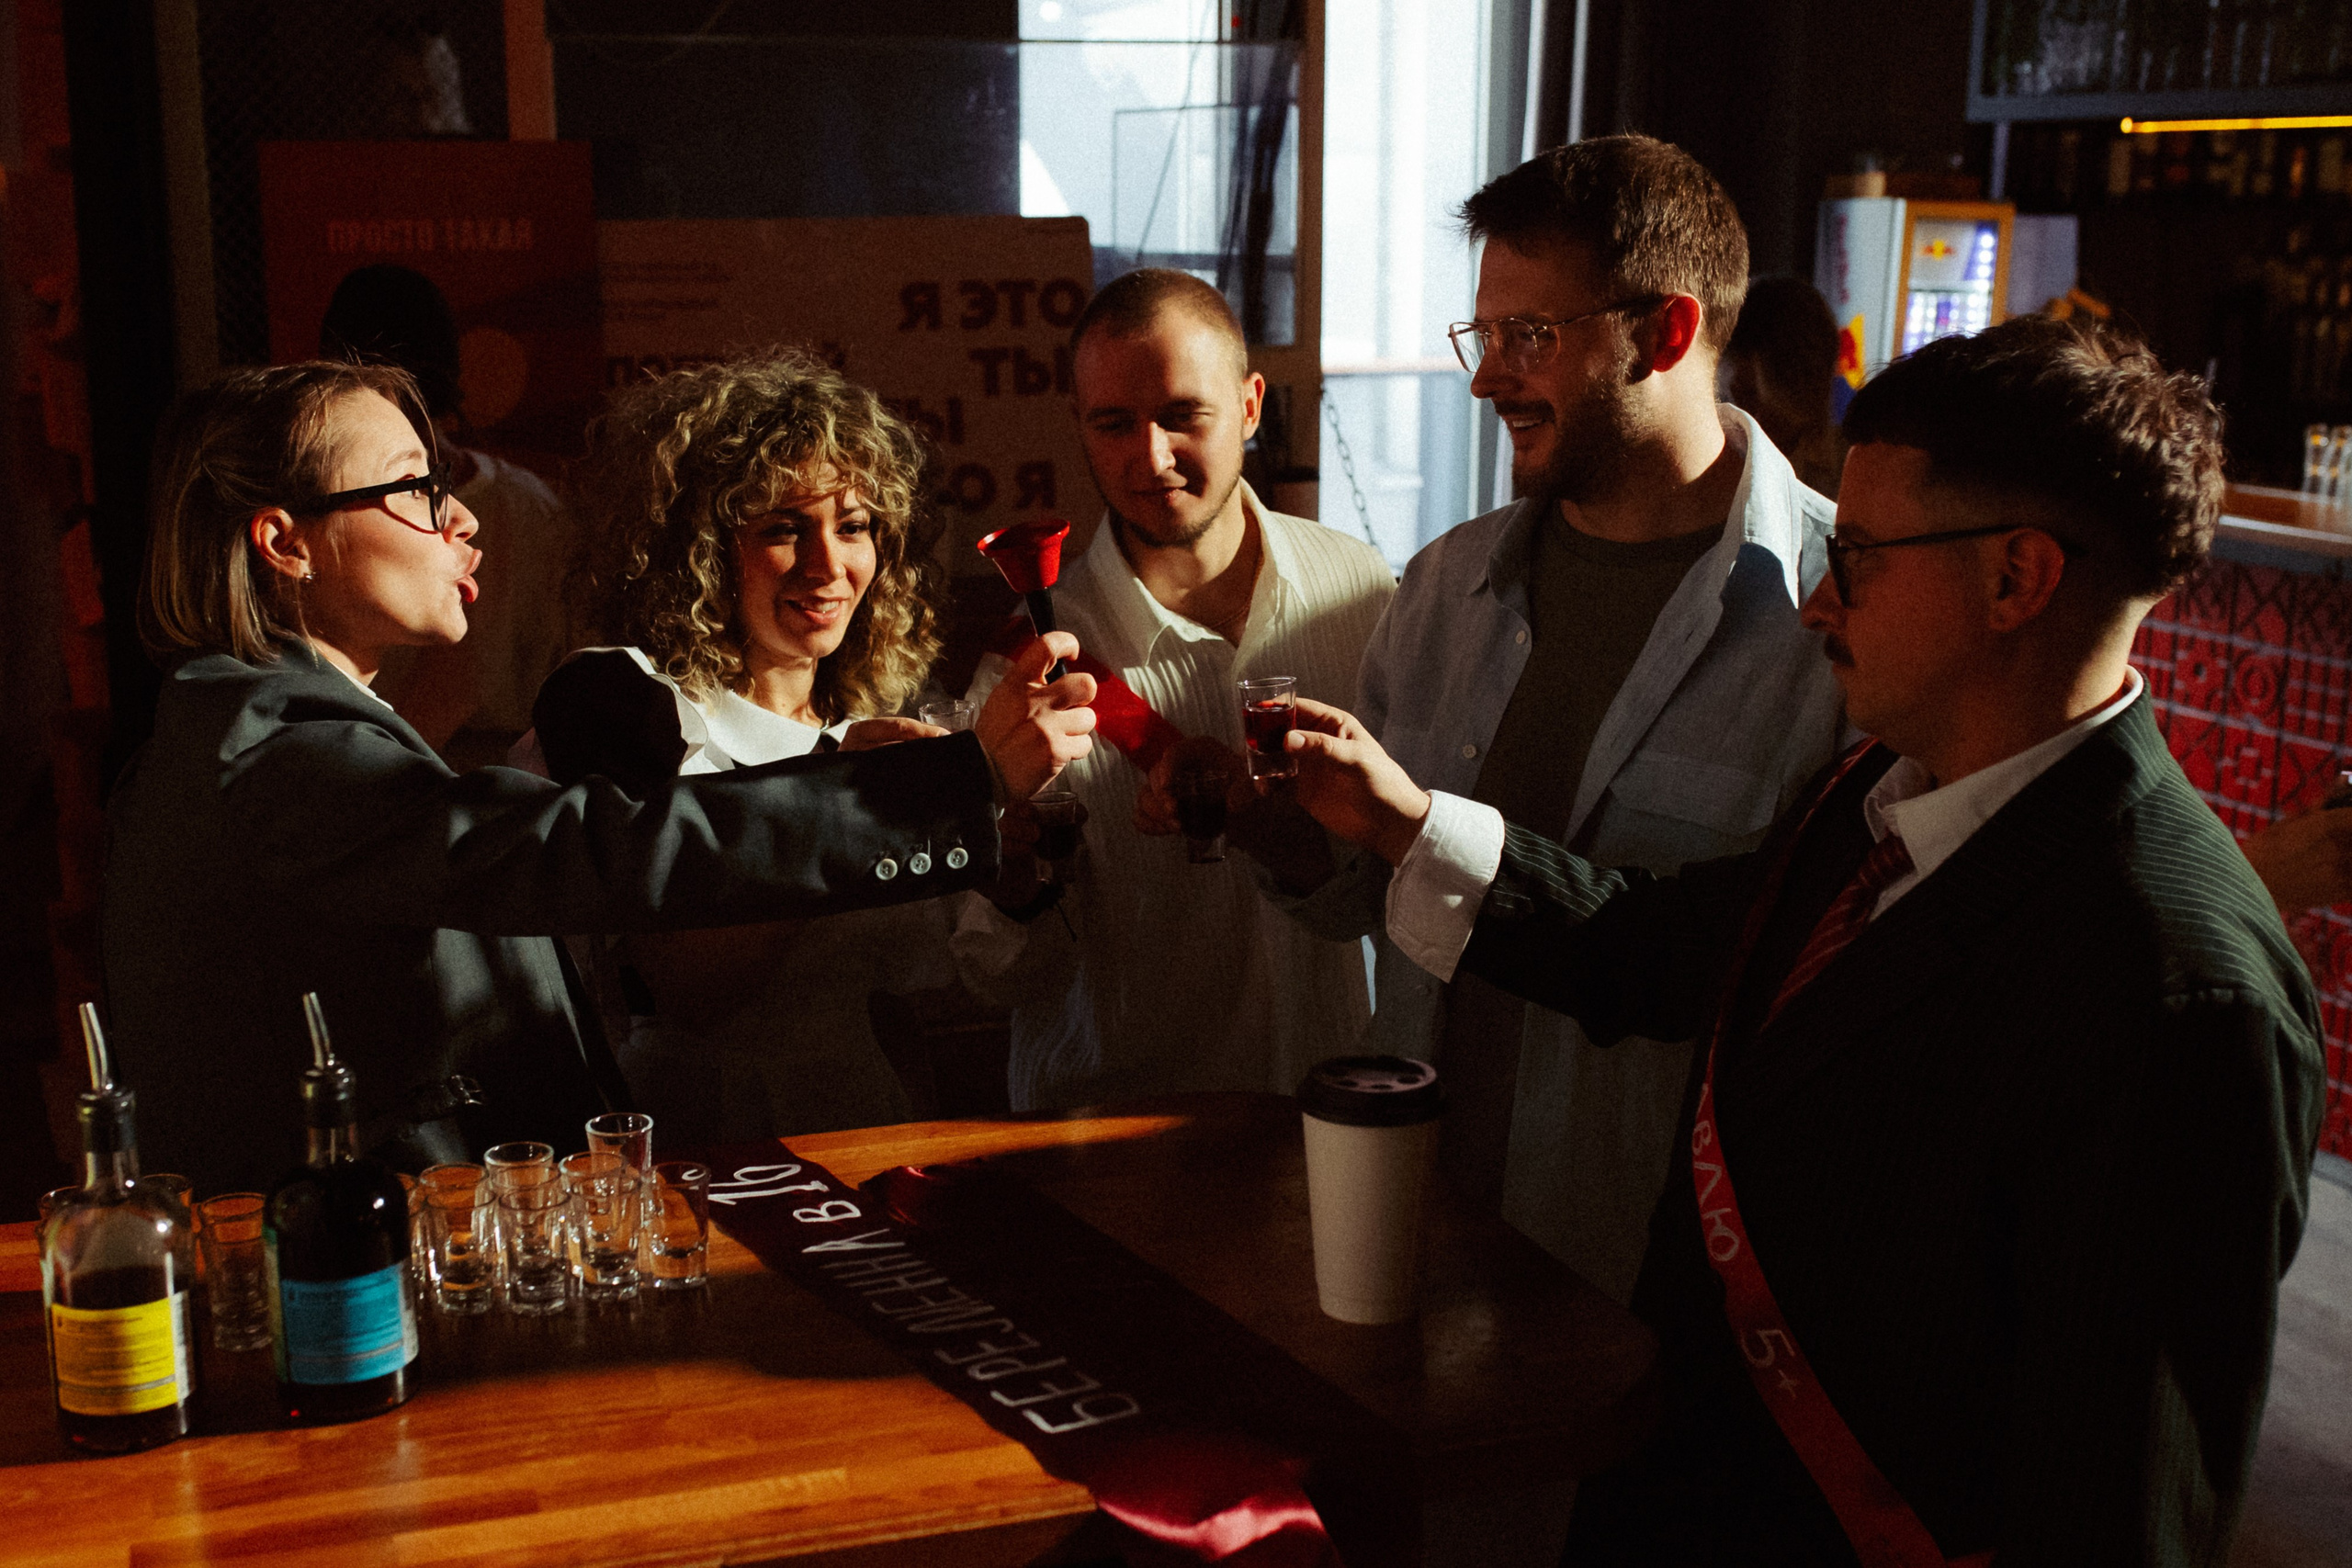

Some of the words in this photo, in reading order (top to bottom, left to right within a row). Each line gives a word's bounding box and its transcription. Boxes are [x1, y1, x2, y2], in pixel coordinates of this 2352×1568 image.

[326, 219, 435, 253] ПРОСТО
[899, 281, 944, 331] Я
[960, 277, 1086, 330] ЭТО
[1014, 460, 1057, 510] Я
[792, 1200, 863, 1224] В
